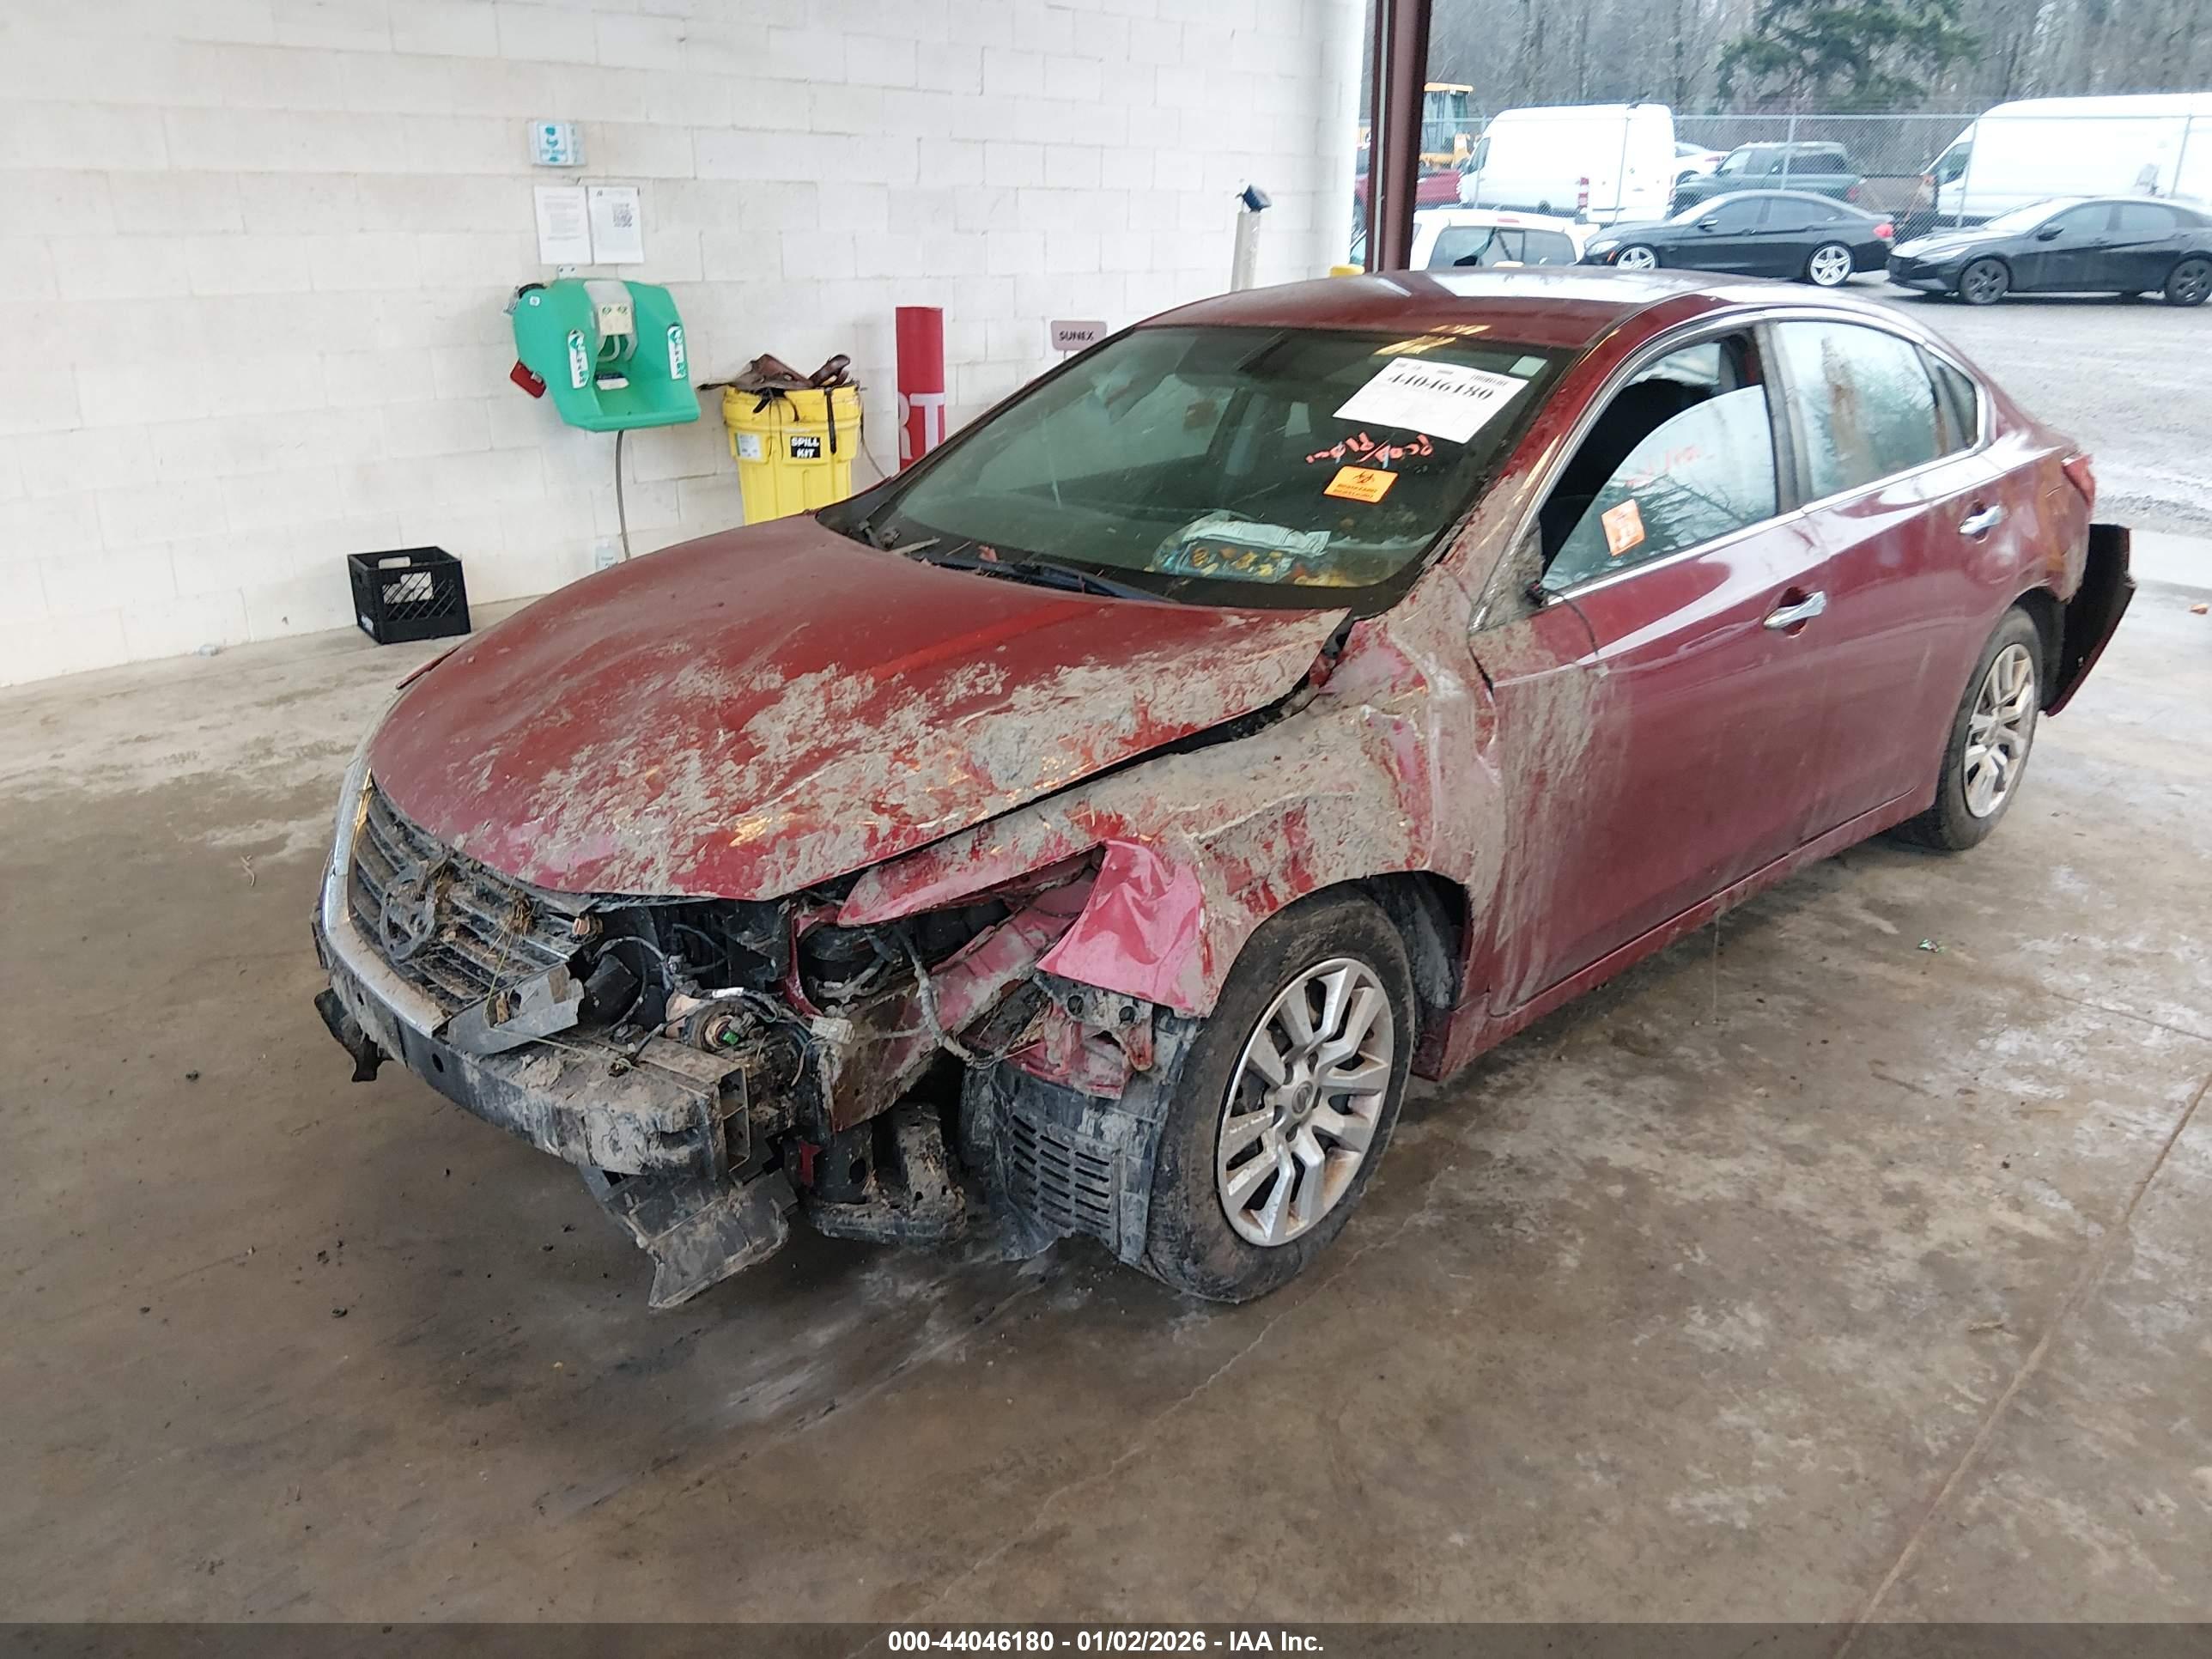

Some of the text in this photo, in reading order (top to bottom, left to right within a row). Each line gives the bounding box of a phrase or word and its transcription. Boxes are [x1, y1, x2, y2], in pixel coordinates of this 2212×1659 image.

[1388, 373, 1494, 399] 44046180
[791, 436, 820, 447] SPILL
[796, 447, 815, 459] KIT
